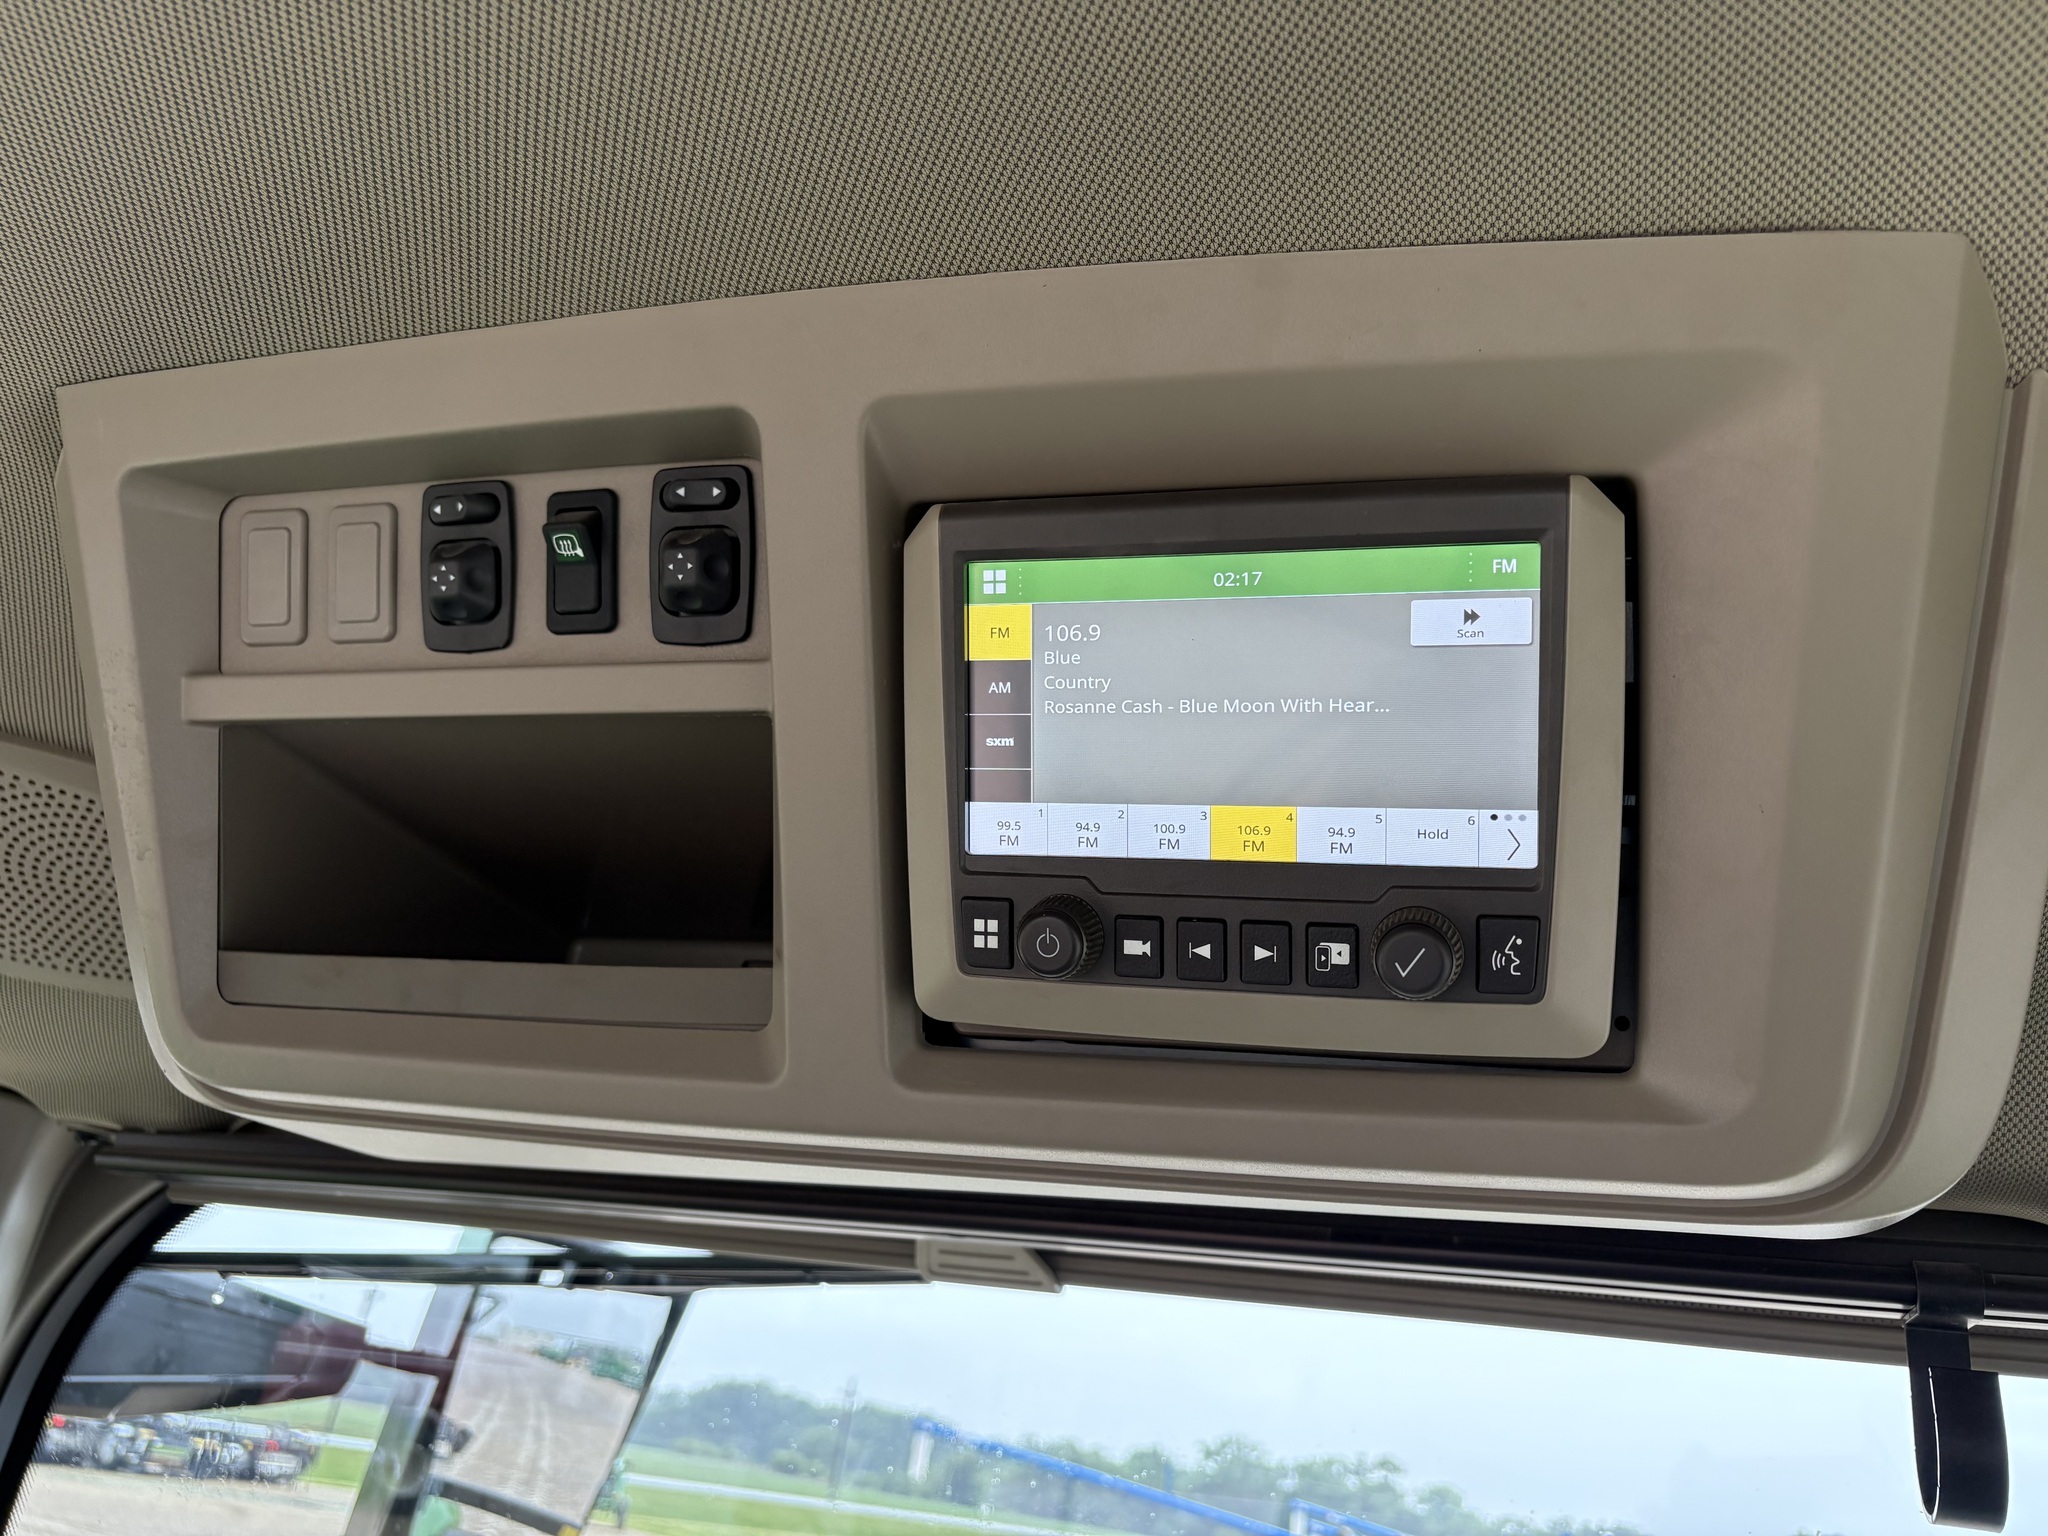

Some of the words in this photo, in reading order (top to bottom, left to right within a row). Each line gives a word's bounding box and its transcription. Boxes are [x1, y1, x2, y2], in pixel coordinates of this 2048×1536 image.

[1492, 558, 1517, 574] FM
[1213, 571, 1263, 587] 02:17
[990, 626, 1010, 639] FM
[1045, 624, 1101, 642] 106.9
[1456, 628, 1485, 639] Scan
[1044, 649, 1081, 665] Blue
[988, 681, 1011, 694] AM
[1044, 675, 1112, 693] Country
[1044, 700, 1117, 714] Rosanne
[1121, 698, 1163, 714] Cash
[1179, 698, 1218, 714] Blue
[1223, 698, 1275, 713] Moon
[1280, 697, 1323, 713] With
[1038, 808, 1043, 818] 1
[1117, 809, 1125, 820] 2
[1200, 810, 1208, 821] 3
[1285, 812, 1294, 823] 4
[1375, 814, 1383, 824] 5
[996, 820, 1022, 831] 99.5
[1467, 815, 1476, 826] 6
[1075, 821, 1101, 833] 94.9
[1153, 823, 1186, 834] 100.9
[1237, 825, 1271, 836] 106.9
[1327, 826, 1356, 838] 94.9
[1417, 828, 1449, 840] Hold
[999, 834, 1019, 847] FM
[1077, 836, 1098, 849] FM
[1159, 838, 1180, 850] FM
[1243, 839, 1265, 853] FM
[1330, 842, 1353, 855] FM
